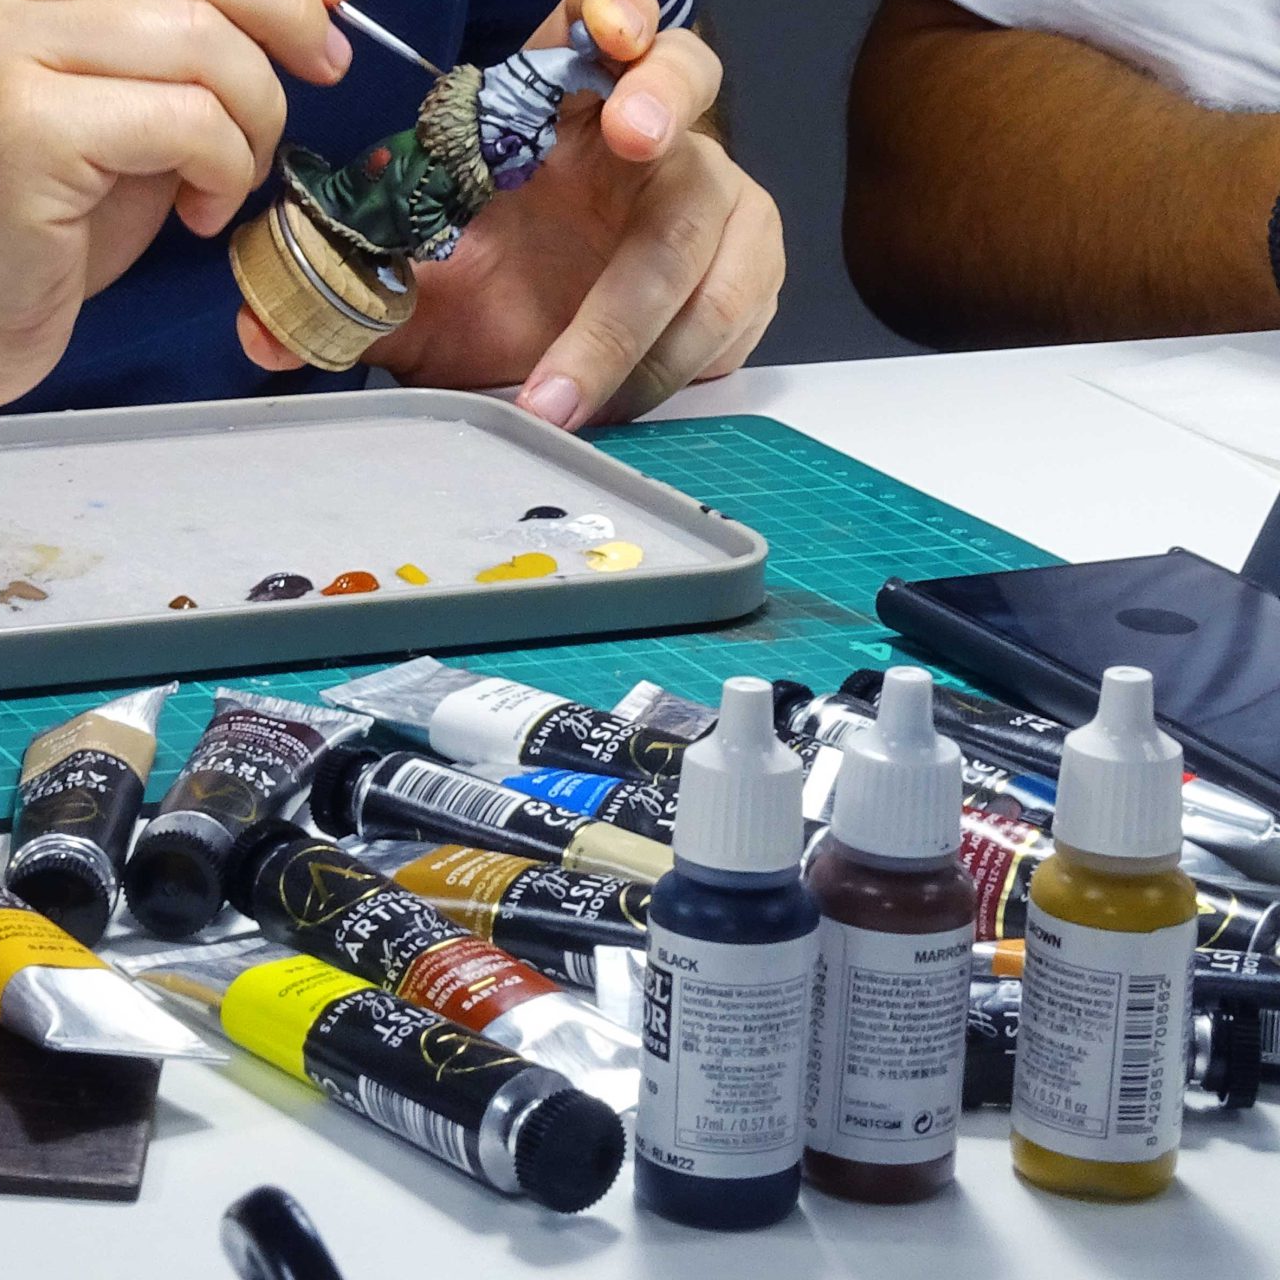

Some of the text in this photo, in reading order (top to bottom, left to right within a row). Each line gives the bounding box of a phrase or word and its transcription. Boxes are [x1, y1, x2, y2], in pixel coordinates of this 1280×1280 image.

[602, 783, 632, 823] PAINT
[383, 936, 430, 992] CRYLIC
[658, 947, 699, 973] BLACK
[425, 967, 460, 1001] BURNT
[374, 1008, 423, 1042] IST
[1146, 979, 1171, 1146] 8 429551 708562
